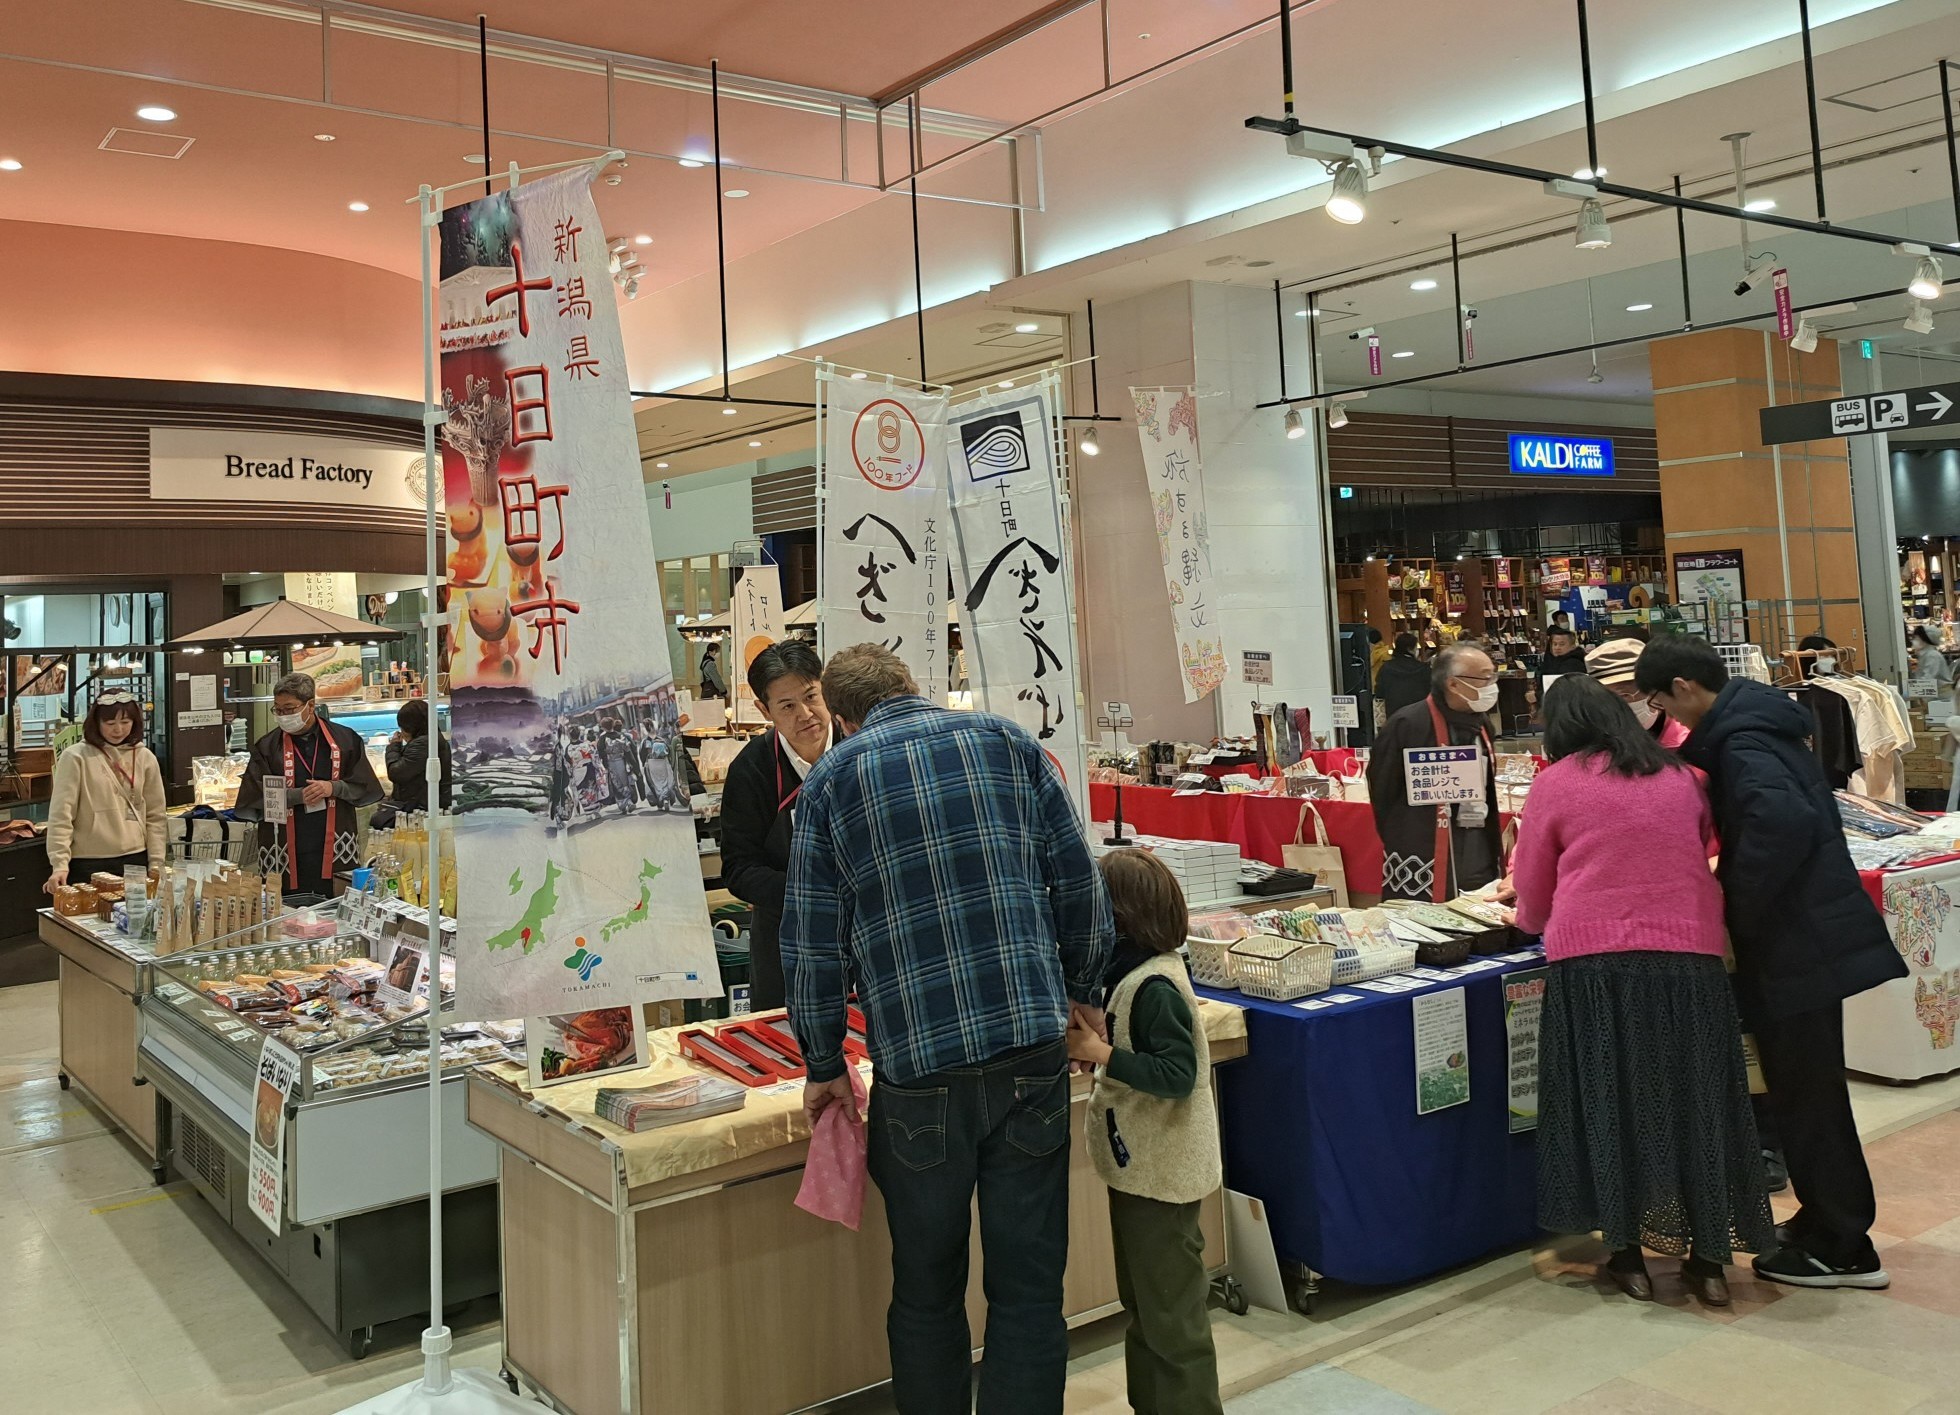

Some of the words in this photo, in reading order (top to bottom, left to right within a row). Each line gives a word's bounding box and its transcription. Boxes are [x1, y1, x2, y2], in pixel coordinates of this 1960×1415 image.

[553, 215, 600, 382] 新潟県
[1836, 401, 1861, 412] BUS
[1873, 399, 1894, 422] P
[1520, 441, 1574, 469] KALDI
[1573, 444, 1602, 457] COFFEE
[486, 242, 580, 675] 十日町市
[1575, 457, 1603, 470] FARM
[225, 455, 294, 480] Bread
[300, 457, 373, 490] Factory
[1705, 559, 1738, 567] フラワーコート
[1418, 752, 1467, 761] お客さまへ
[1411, 765, 1451, 776] お会計は
[1412, 776, 1460, 789] 食品レジで
[1413, 789, 1479, 801] お願いいたします。
[1437, 818, 1448, 829] 10
[562, 982, 612, 994] TOKAMACHI
